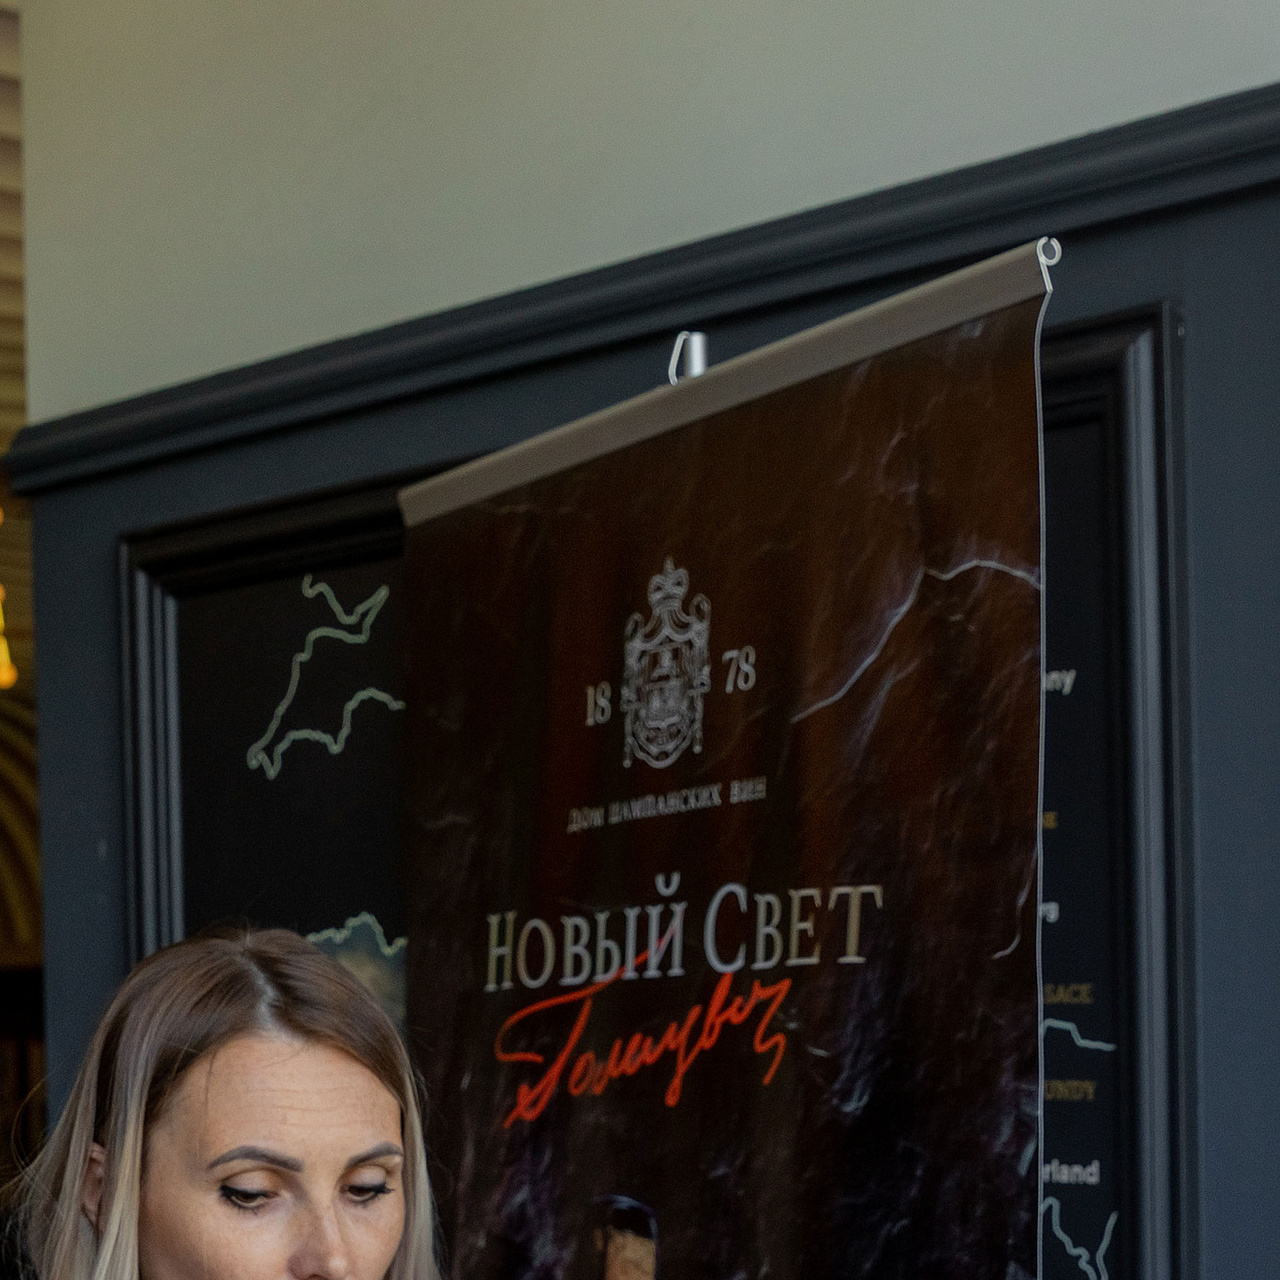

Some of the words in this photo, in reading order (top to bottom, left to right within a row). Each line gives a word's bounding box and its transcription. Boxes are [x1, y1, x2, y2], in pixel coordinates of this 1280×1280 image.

[585, 680, 612, 727] 18
[722, 645, 757, 694] 78
[483, 871, 687, 993] НОВЫЙ
[703, 882, 884, 973] СВЕТ
[1043, 1158, 1100, 1185] rland
